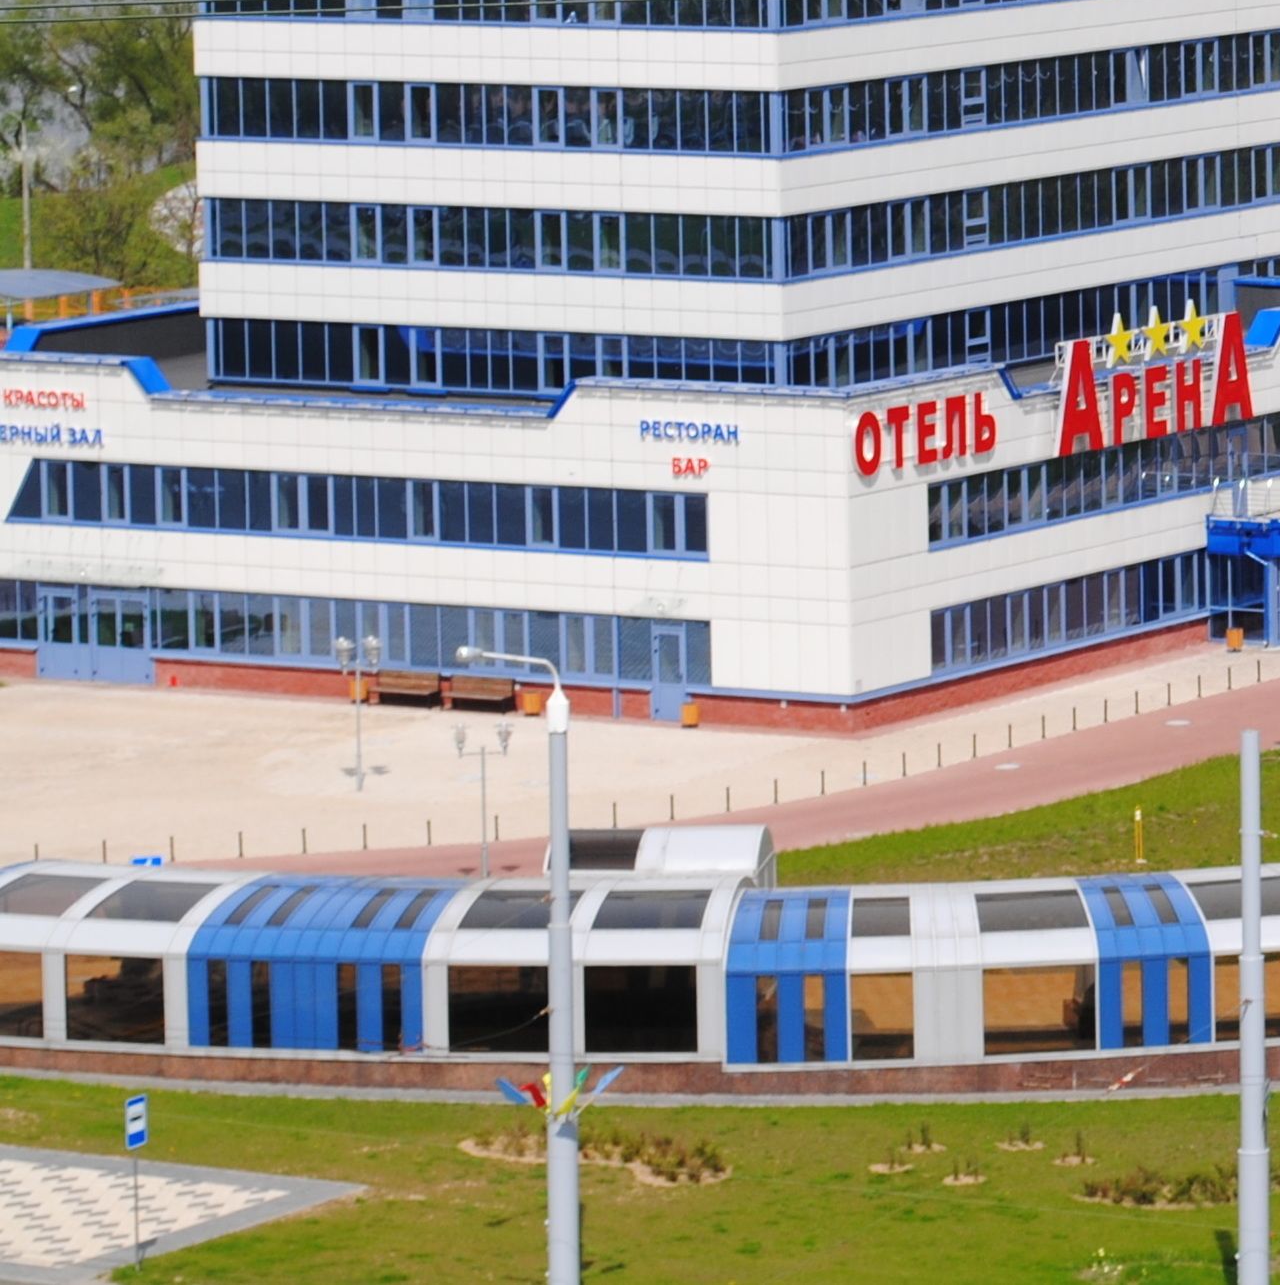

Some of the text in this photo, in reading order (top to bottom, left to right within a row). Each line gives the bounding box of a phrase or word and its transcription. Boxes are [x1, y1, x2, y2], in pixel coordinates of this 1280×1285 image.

[3, 388, 86, 409] КРАСОТЫ
[853, 311, 1256, 477] ОТЕЛЬ АРЕНА
[67, 427, 104, 445] ЗАЛ
[639, 419, 740, 443] РЕСТОРАН
[671, 456, 710, 476] БАР
